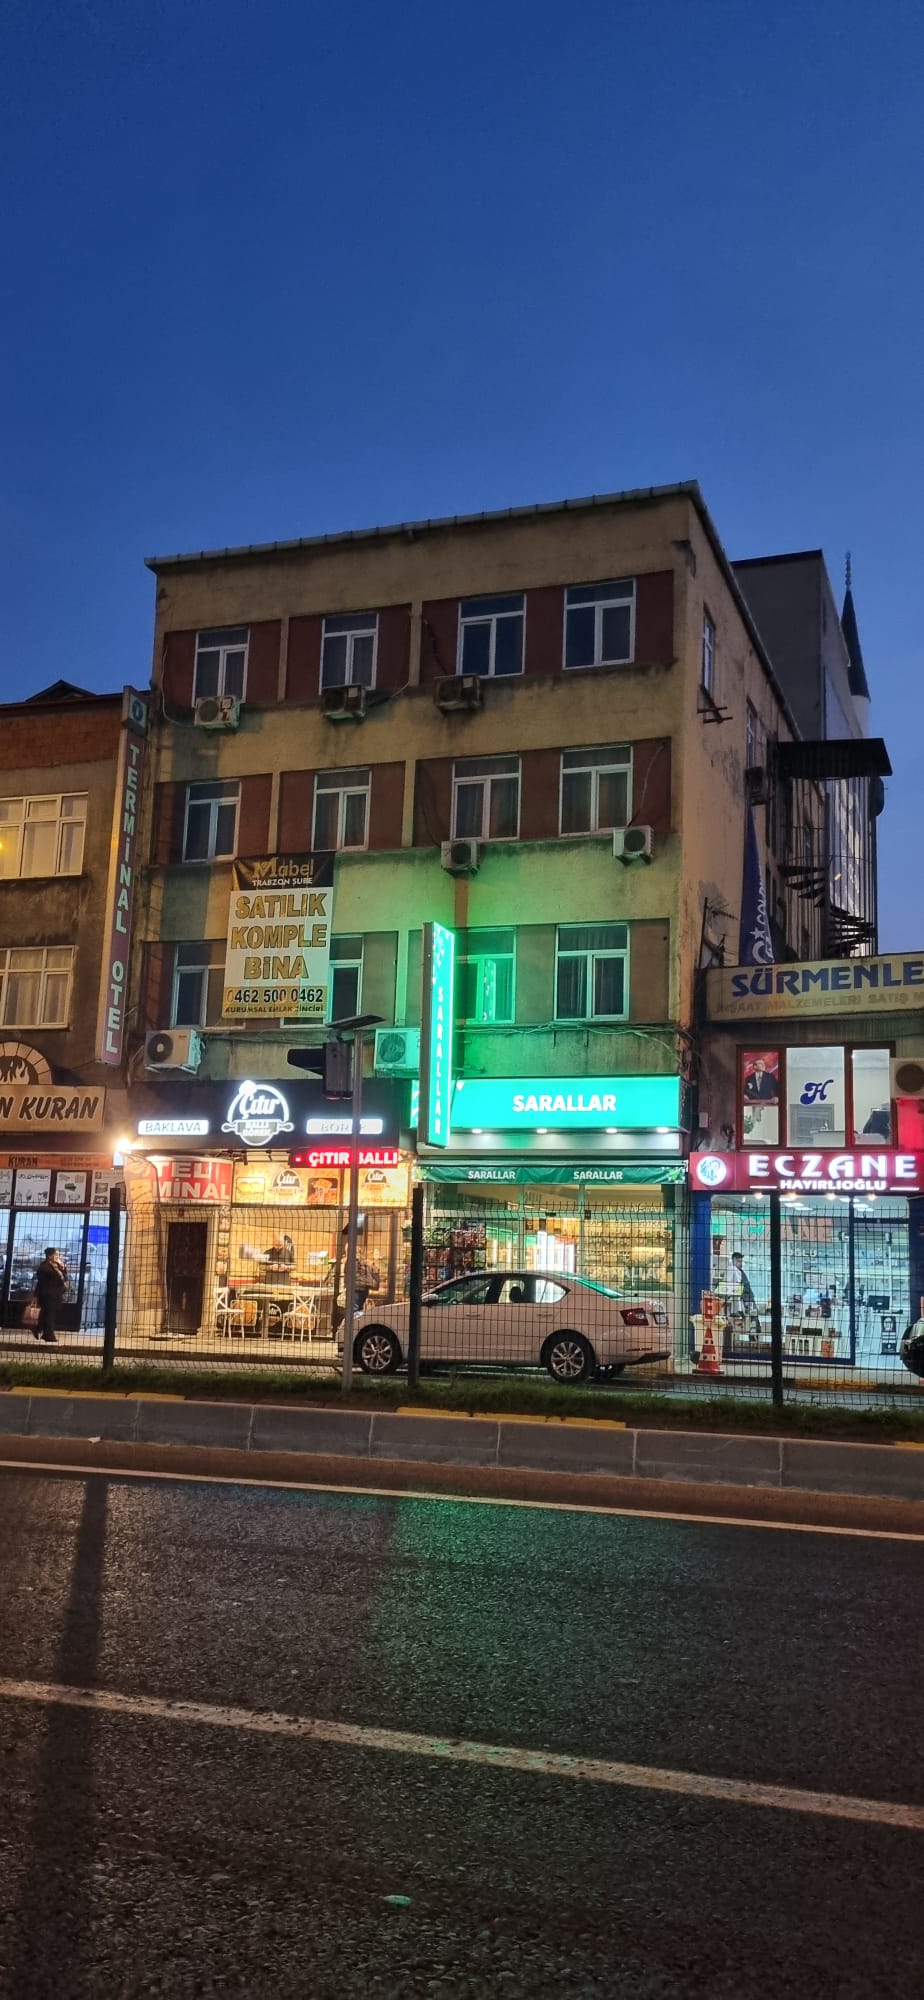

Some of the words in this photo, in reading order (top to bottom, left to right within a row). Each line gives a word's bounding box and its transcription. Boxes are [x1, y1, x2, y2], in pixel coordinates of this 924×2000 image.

[115, 744, 140, 934] TERMİNAL
[252, 856, 314, 878] Mabel
[252, 879, 290, 887] TRABZON
[235, 892, 326, 919] SATILIK
[231, 924, 327, 949] KOMPLE
[244, 955, 309, 980] BİNA
[731, 960, 924, 997] SÜRMENLE
[106, 961, 123, 1053] OTEL
[227, 989, 259, 1005] 0462
[263, 988, 287, 1004] 500
[291, 988, 323, 1003] 0462
[434, 986, 443, 1135] SARALLAR
[19, 1096, 99, 1120] KURAN
[512, 1094, 617, 1112] SARALLAR
[145, 1122, 201, 1133] BAKLAVA
[8, 1156, 38, 1167] KURAN
[748, 1154, 918, 1179] ECZANE
[468, 1170, 516, 1179] SARALLAR
[573, 1170, 624, 1180] SARALLAR
[780, 1179, 887, 1191] HAYIRLIOĞLU
